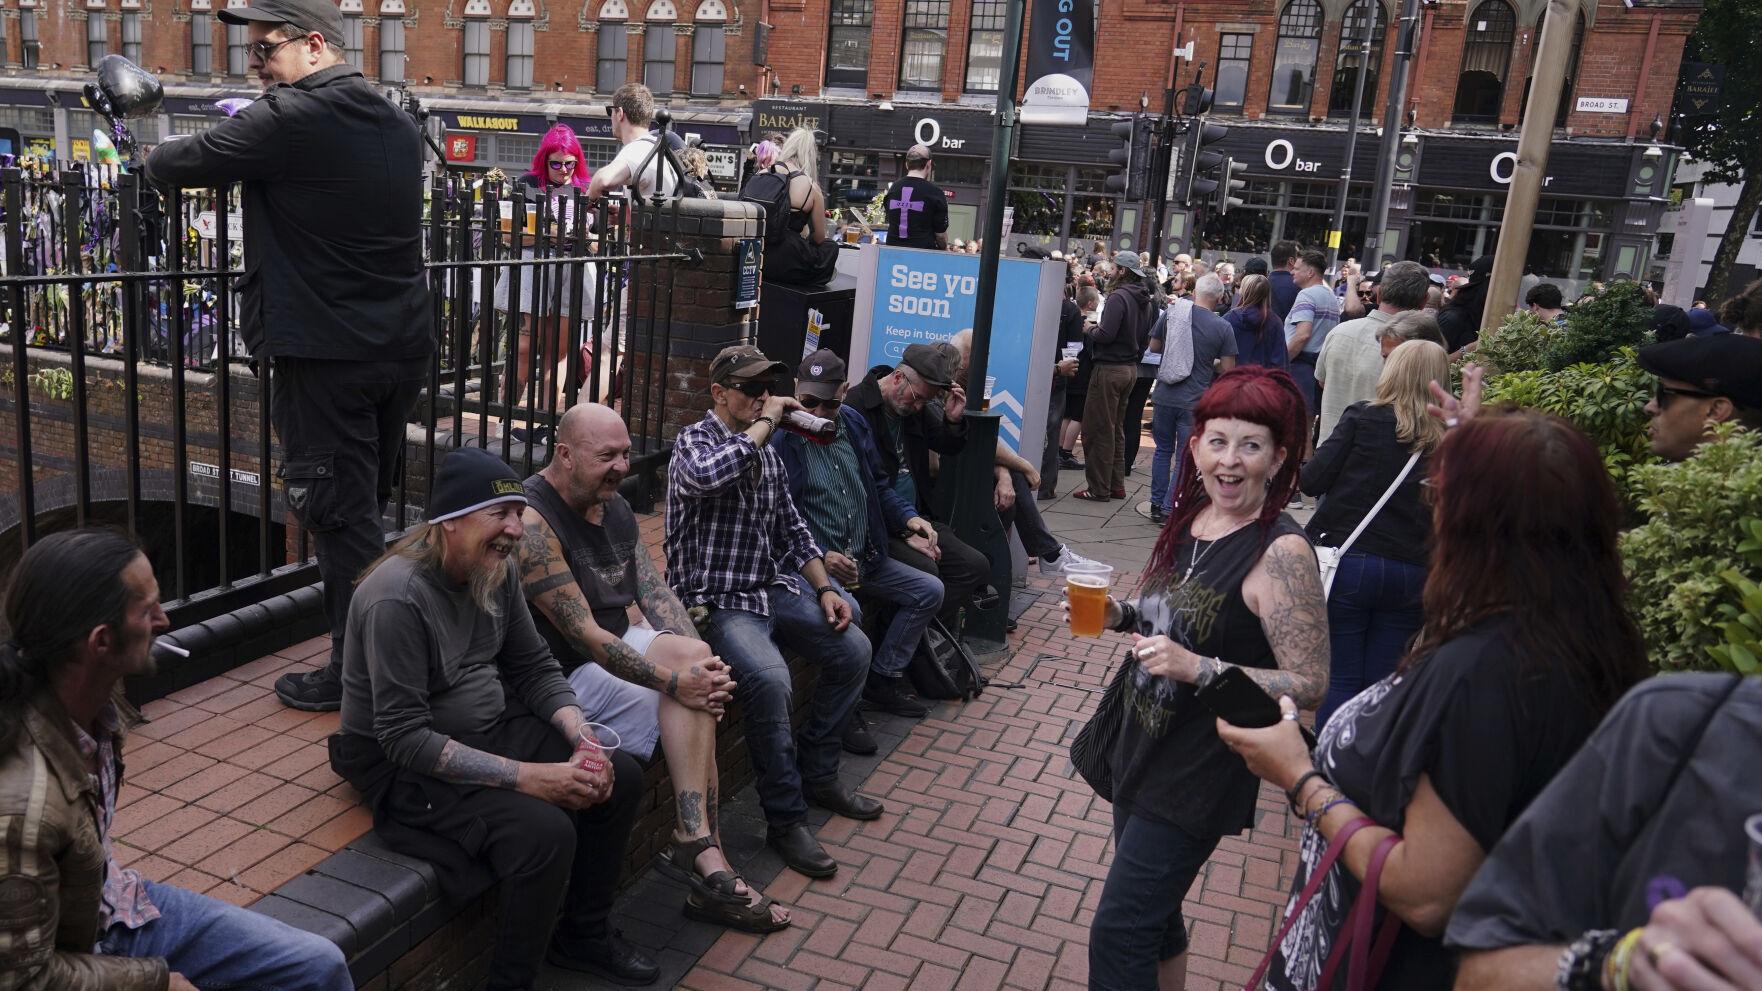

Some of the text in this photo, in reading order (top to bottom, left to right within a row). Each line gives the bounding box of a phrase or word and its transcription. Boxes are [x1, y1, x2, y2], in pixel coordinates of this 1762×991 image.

[1053, 18, 1073, 61] OUT
[1034, 87, 1078, 96] BRINDLEY
[457, 115, 518, 130] WALKABOUT
[585, 125, 601, 134] eat,
[914, 118, 965, 148] O bar
[1264, 138, 1321, 172] O bar
[1490, 152, 1517, 184] O
[743, 265, 757, 275] CCTV
[891, 264, 979, 297] See yo
[888, 294, 951, 318] soon
[886, 325, 911, 339] Keep
[913, 330, 923, 339] in
[192, 464, 258, 483] BROAD STT TUNNEL
